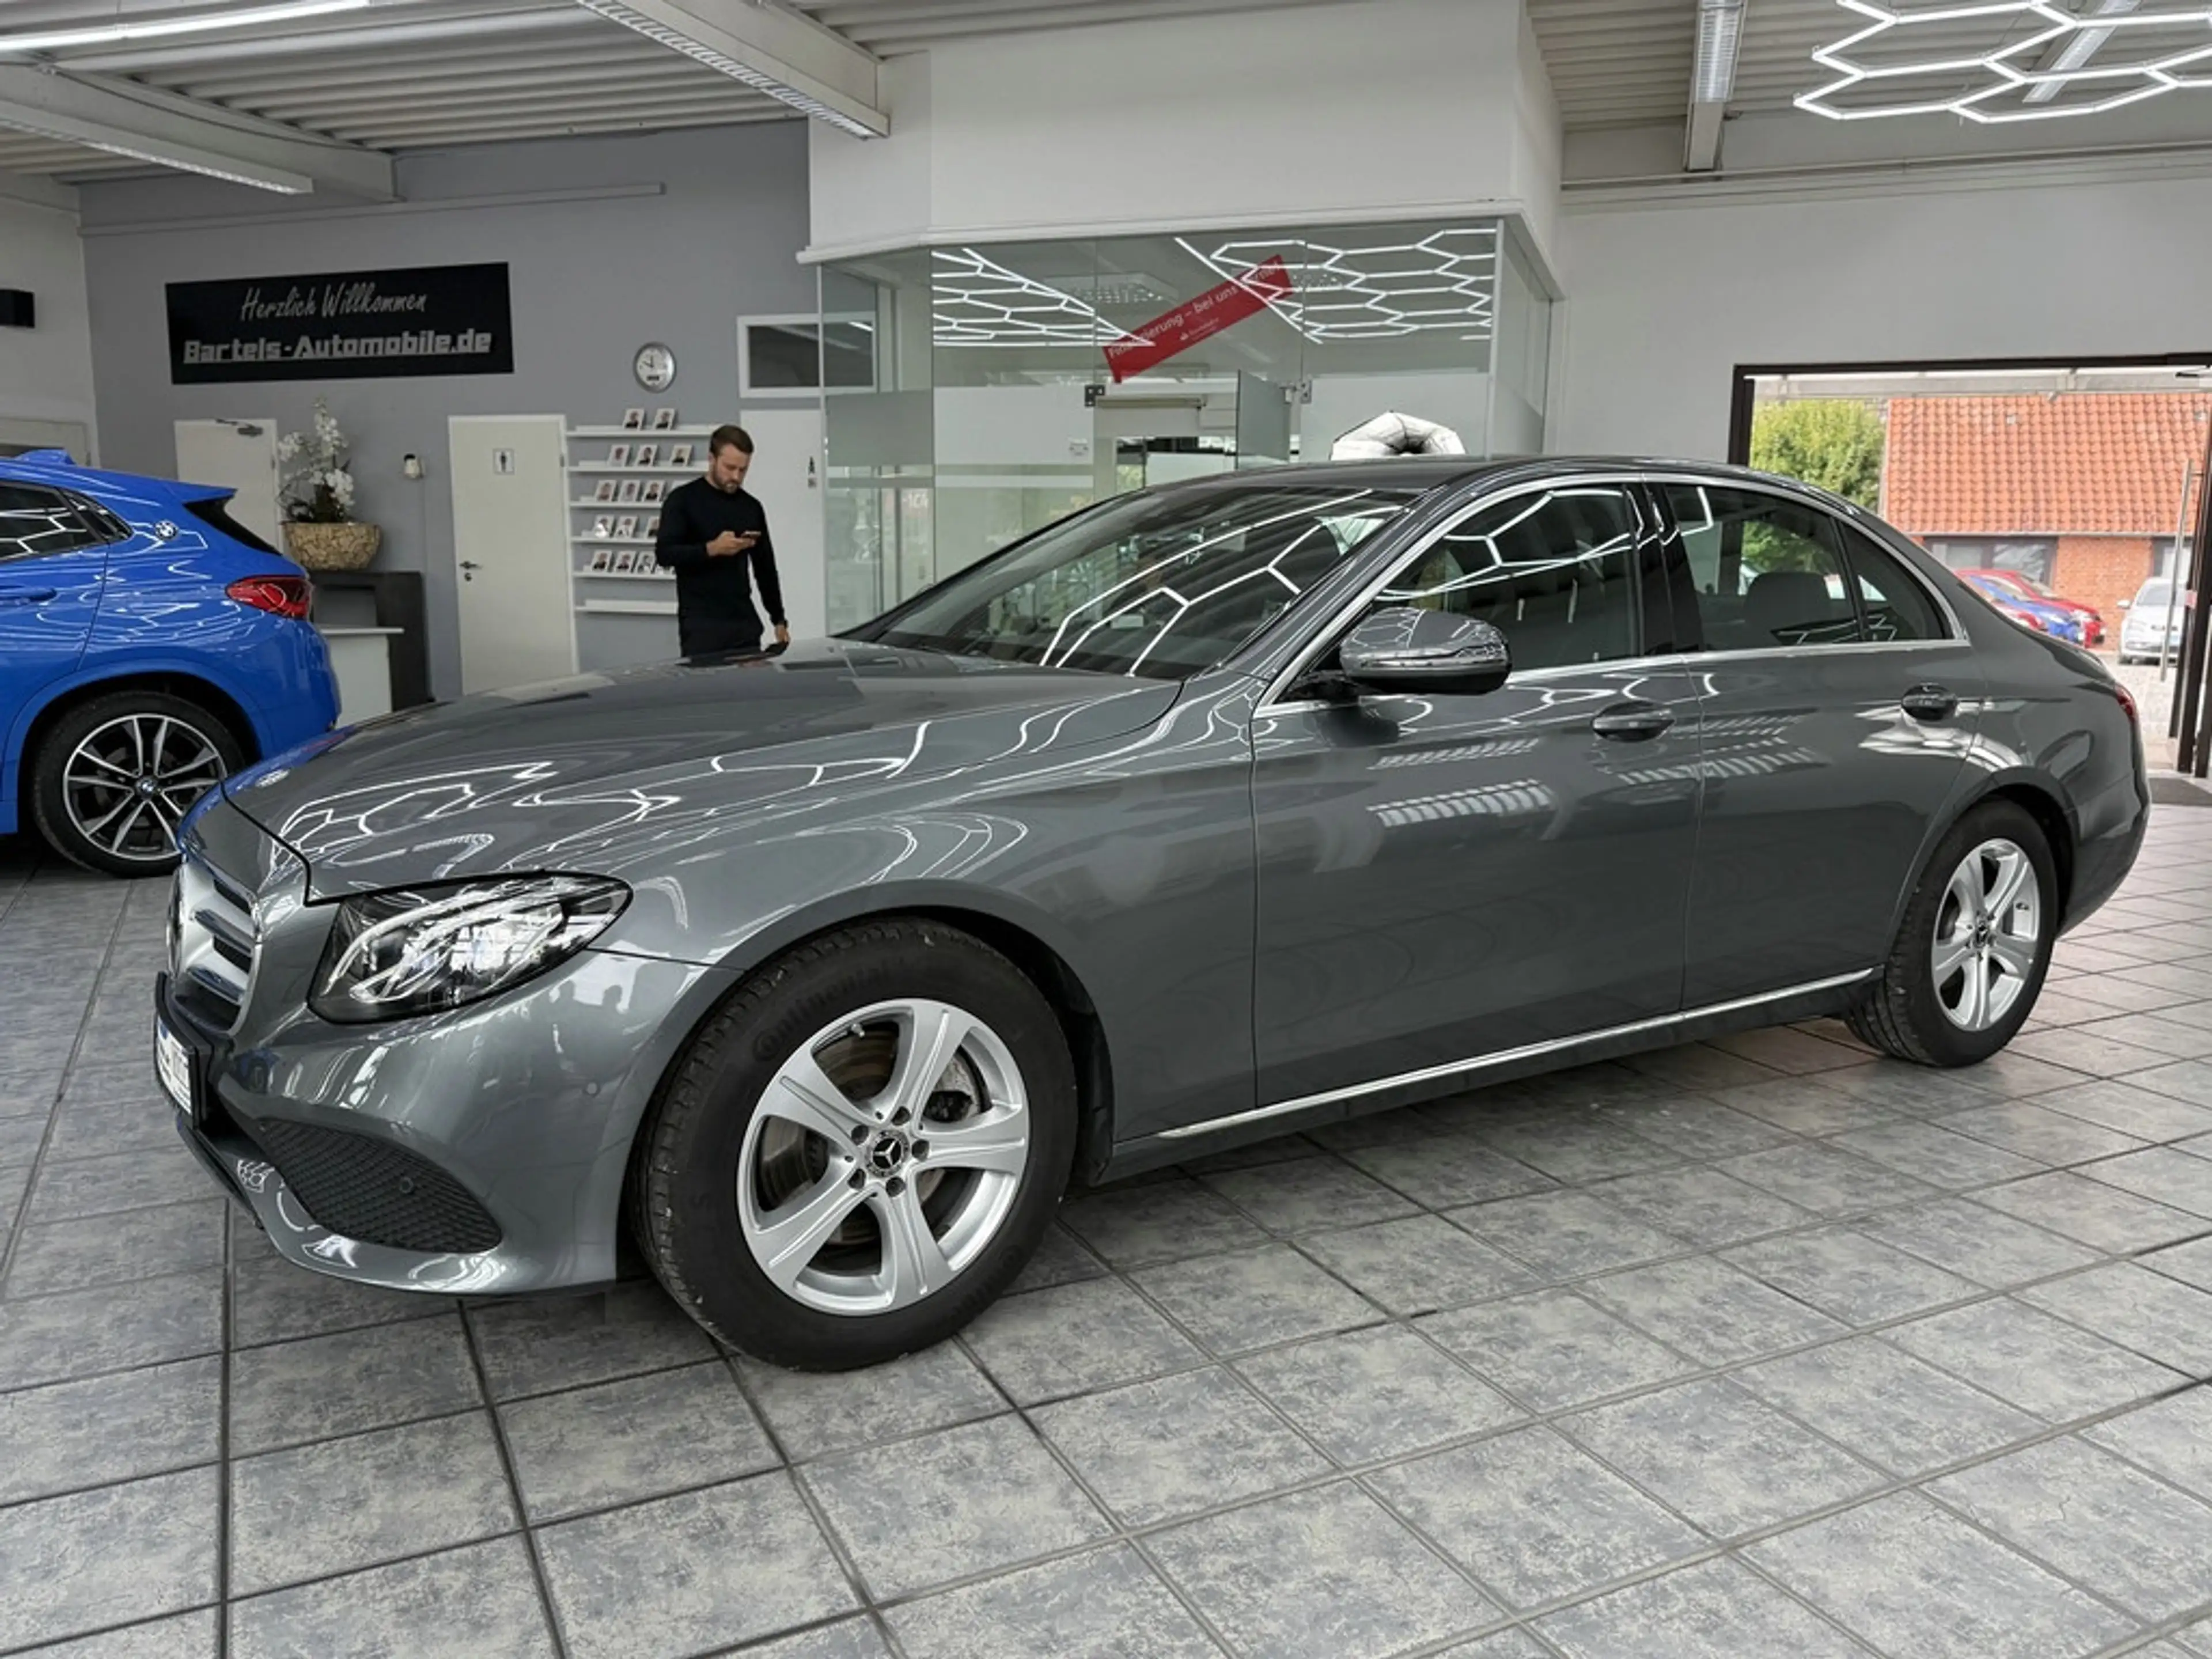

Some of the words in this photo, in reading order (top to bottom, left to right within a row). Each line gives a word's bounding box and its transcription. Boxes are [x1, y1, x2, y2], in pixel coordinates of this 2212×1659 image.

[241, 286, 316, 321] Herzlich
[321, 282, 427, 317] Willkommen
[183, 328, 493, 364] Bartels-Automobile.de
[1107, 314, 1185, 359] Finierung
